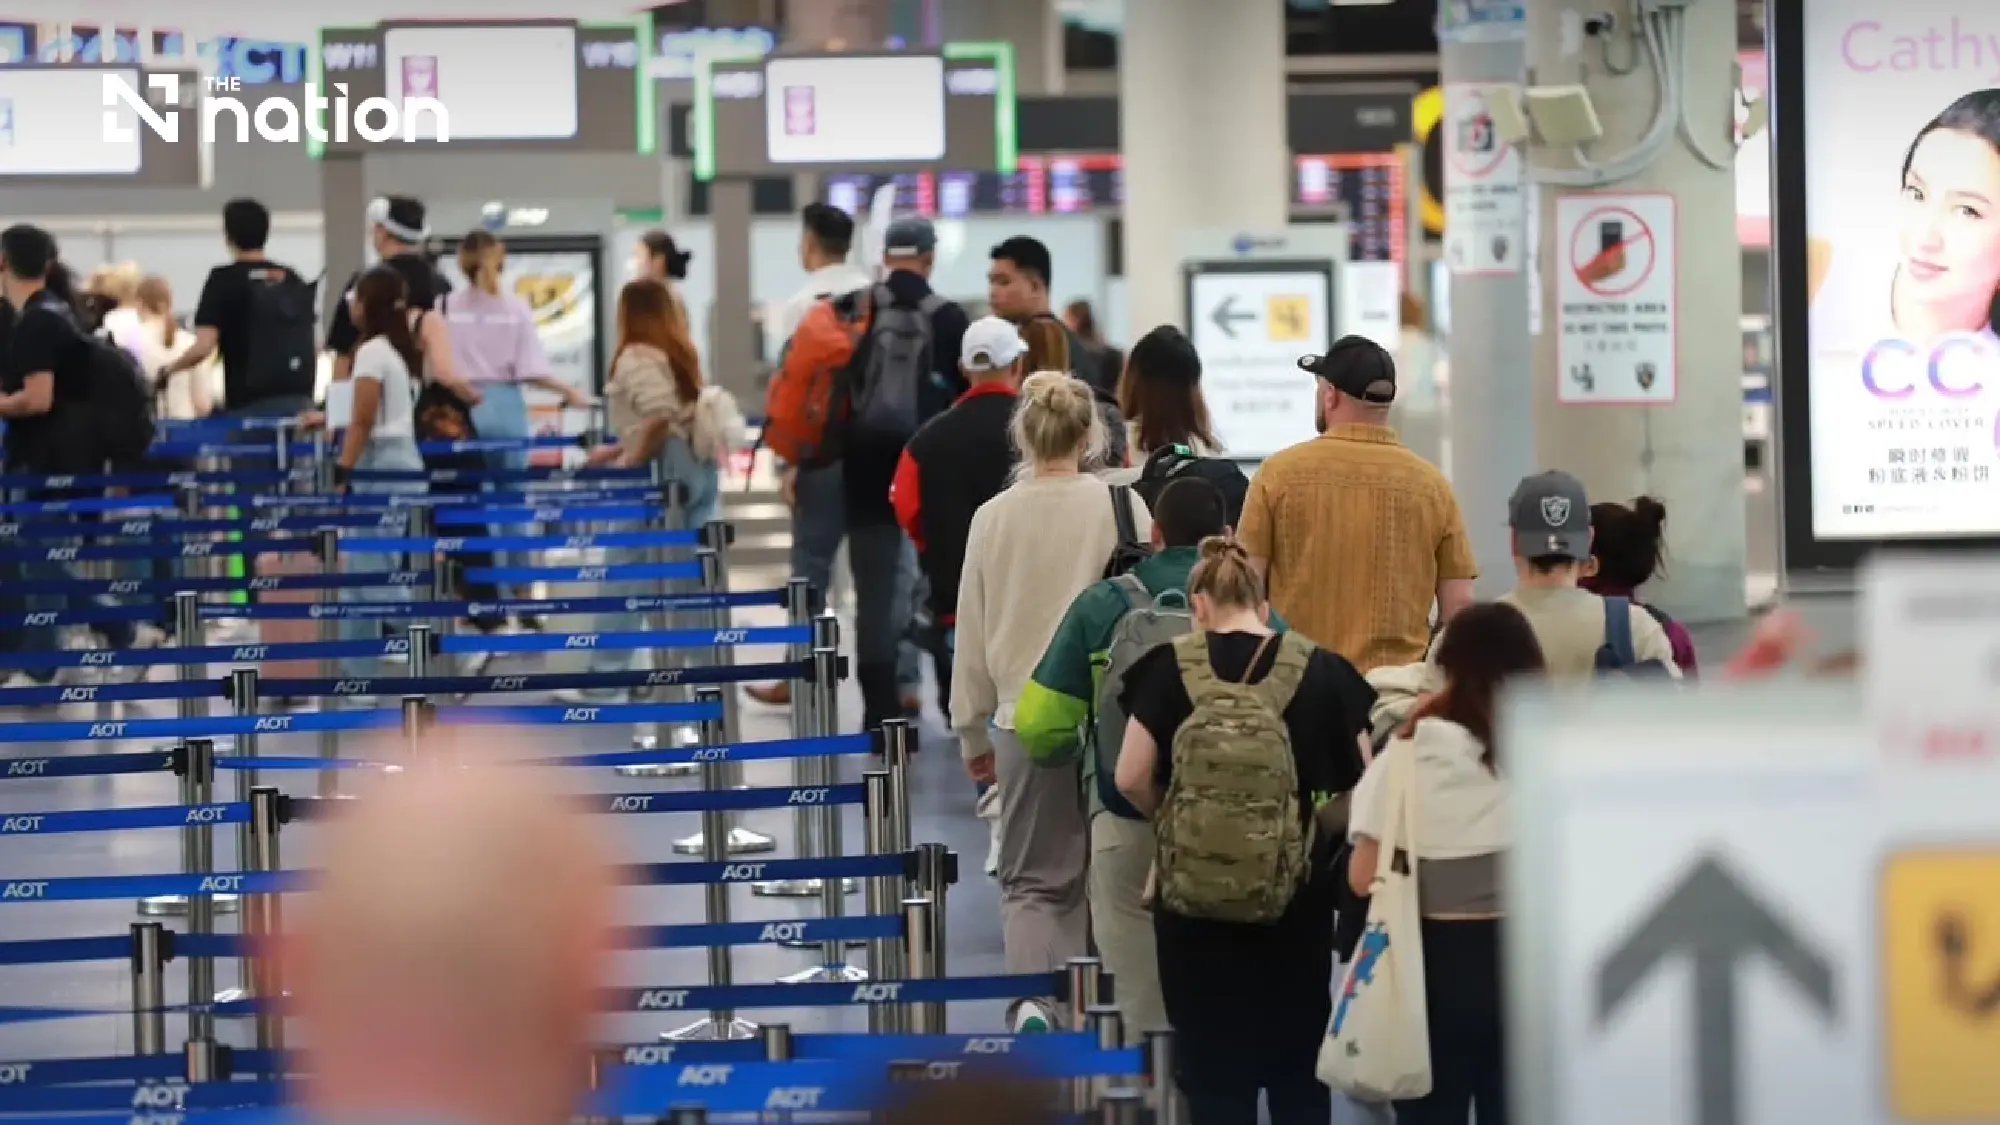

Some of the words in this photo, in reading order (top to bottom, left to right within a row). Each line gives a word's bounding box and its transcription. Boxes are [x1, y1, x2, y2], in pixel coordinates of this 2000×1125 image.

[23, 612, 58, 626] AOT
[565, 635, 600, 648] AOT
[714, 630, 748, 643] AOT
[233, 646, 268, 660] AOT
[384, 639, 409, 652] AO
[80, 652, 117, 664] AOT
[491, 677, 528, 690] AOT
[646, 671, 684, 684] AOT
[60, 687, 98, 700] AOT
[334, 680, 371, 693] AOT
[563, 707, 600, 721] AOT
[89, 723, 128, 737] AOT
[254, 717, 292, 730] AOT
[692, 748, 730, 761] AOT
[8, 760, 48, 775] AOT
[788, 788, 829, 803] AOT
[610, 796, 654, 811] AOT
[186, 808, 227, 823] AOT
[2, 816, 45, 831] AOT
[722, 864, 766, 880] AOT
[2, 882, 49, 898] AOT
[200, 875, 244, 891] AOT
[759, 923, 807, 941] AOT
[851, 981, 904, 1001] AOT
[638, 990, 690, 1009] AOT
[963, 1037, 1016, 1054] AOT
[624, 1046, 675, 1065] AOT
[677, 1064, 734, 1086] AOT
[133, 1084, 191, 1109] AOT
[765, 1086, 826, 1109] AOT
